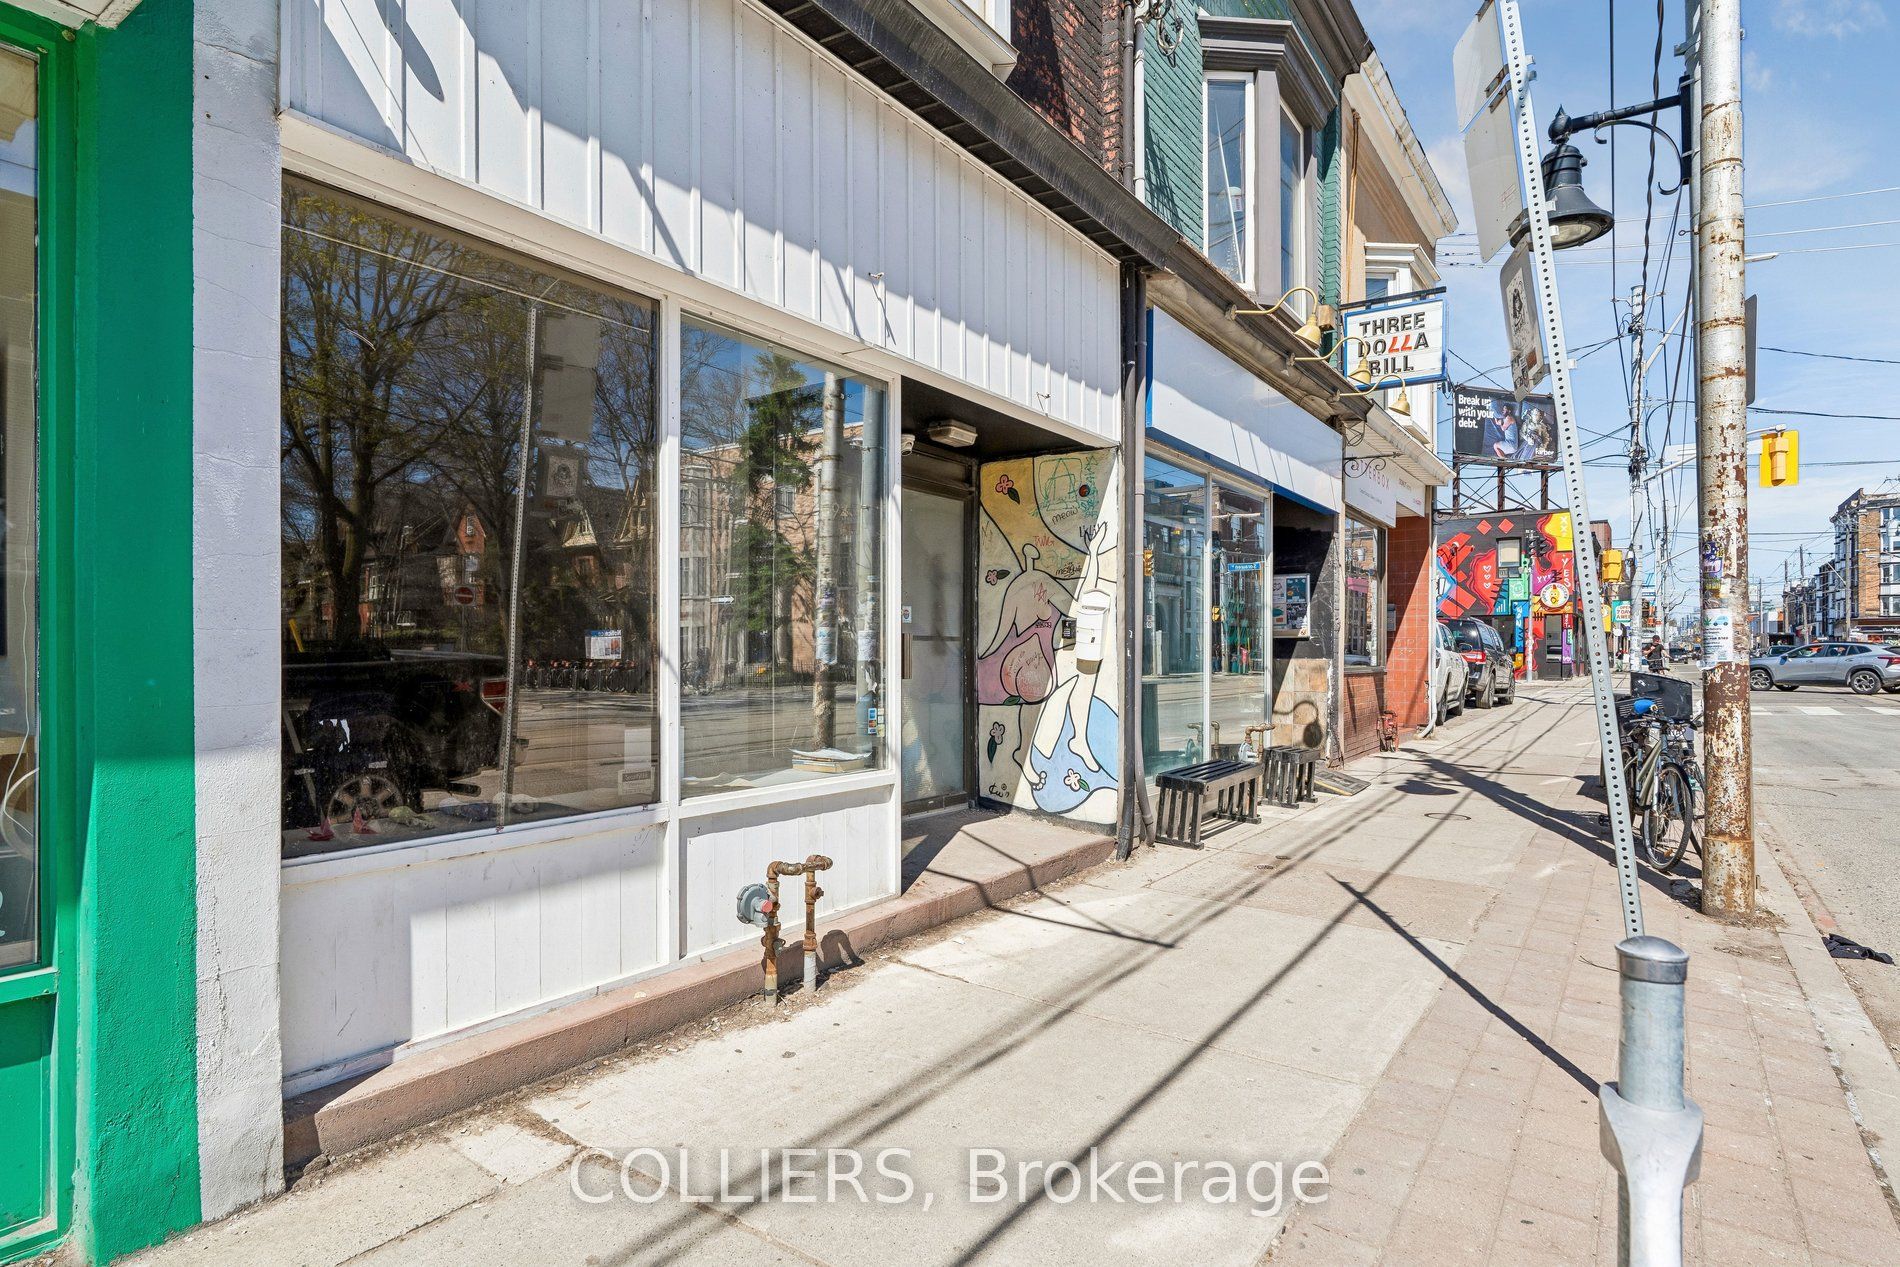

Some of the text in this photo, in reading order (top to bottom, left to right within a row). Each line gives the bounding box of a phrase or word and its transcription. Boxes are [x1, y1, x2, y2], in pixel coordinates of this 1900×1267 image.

[1359, 312, 1425, 338] THREE
[1358, 332, 1429, 357] DOLLA
[1369, 355, 1414, 377] BILL
[1458, 394, 1492, 409] Break up
[1458, 406, 1494, 420] with your
[1458, 417, 1478, 429] debt.
